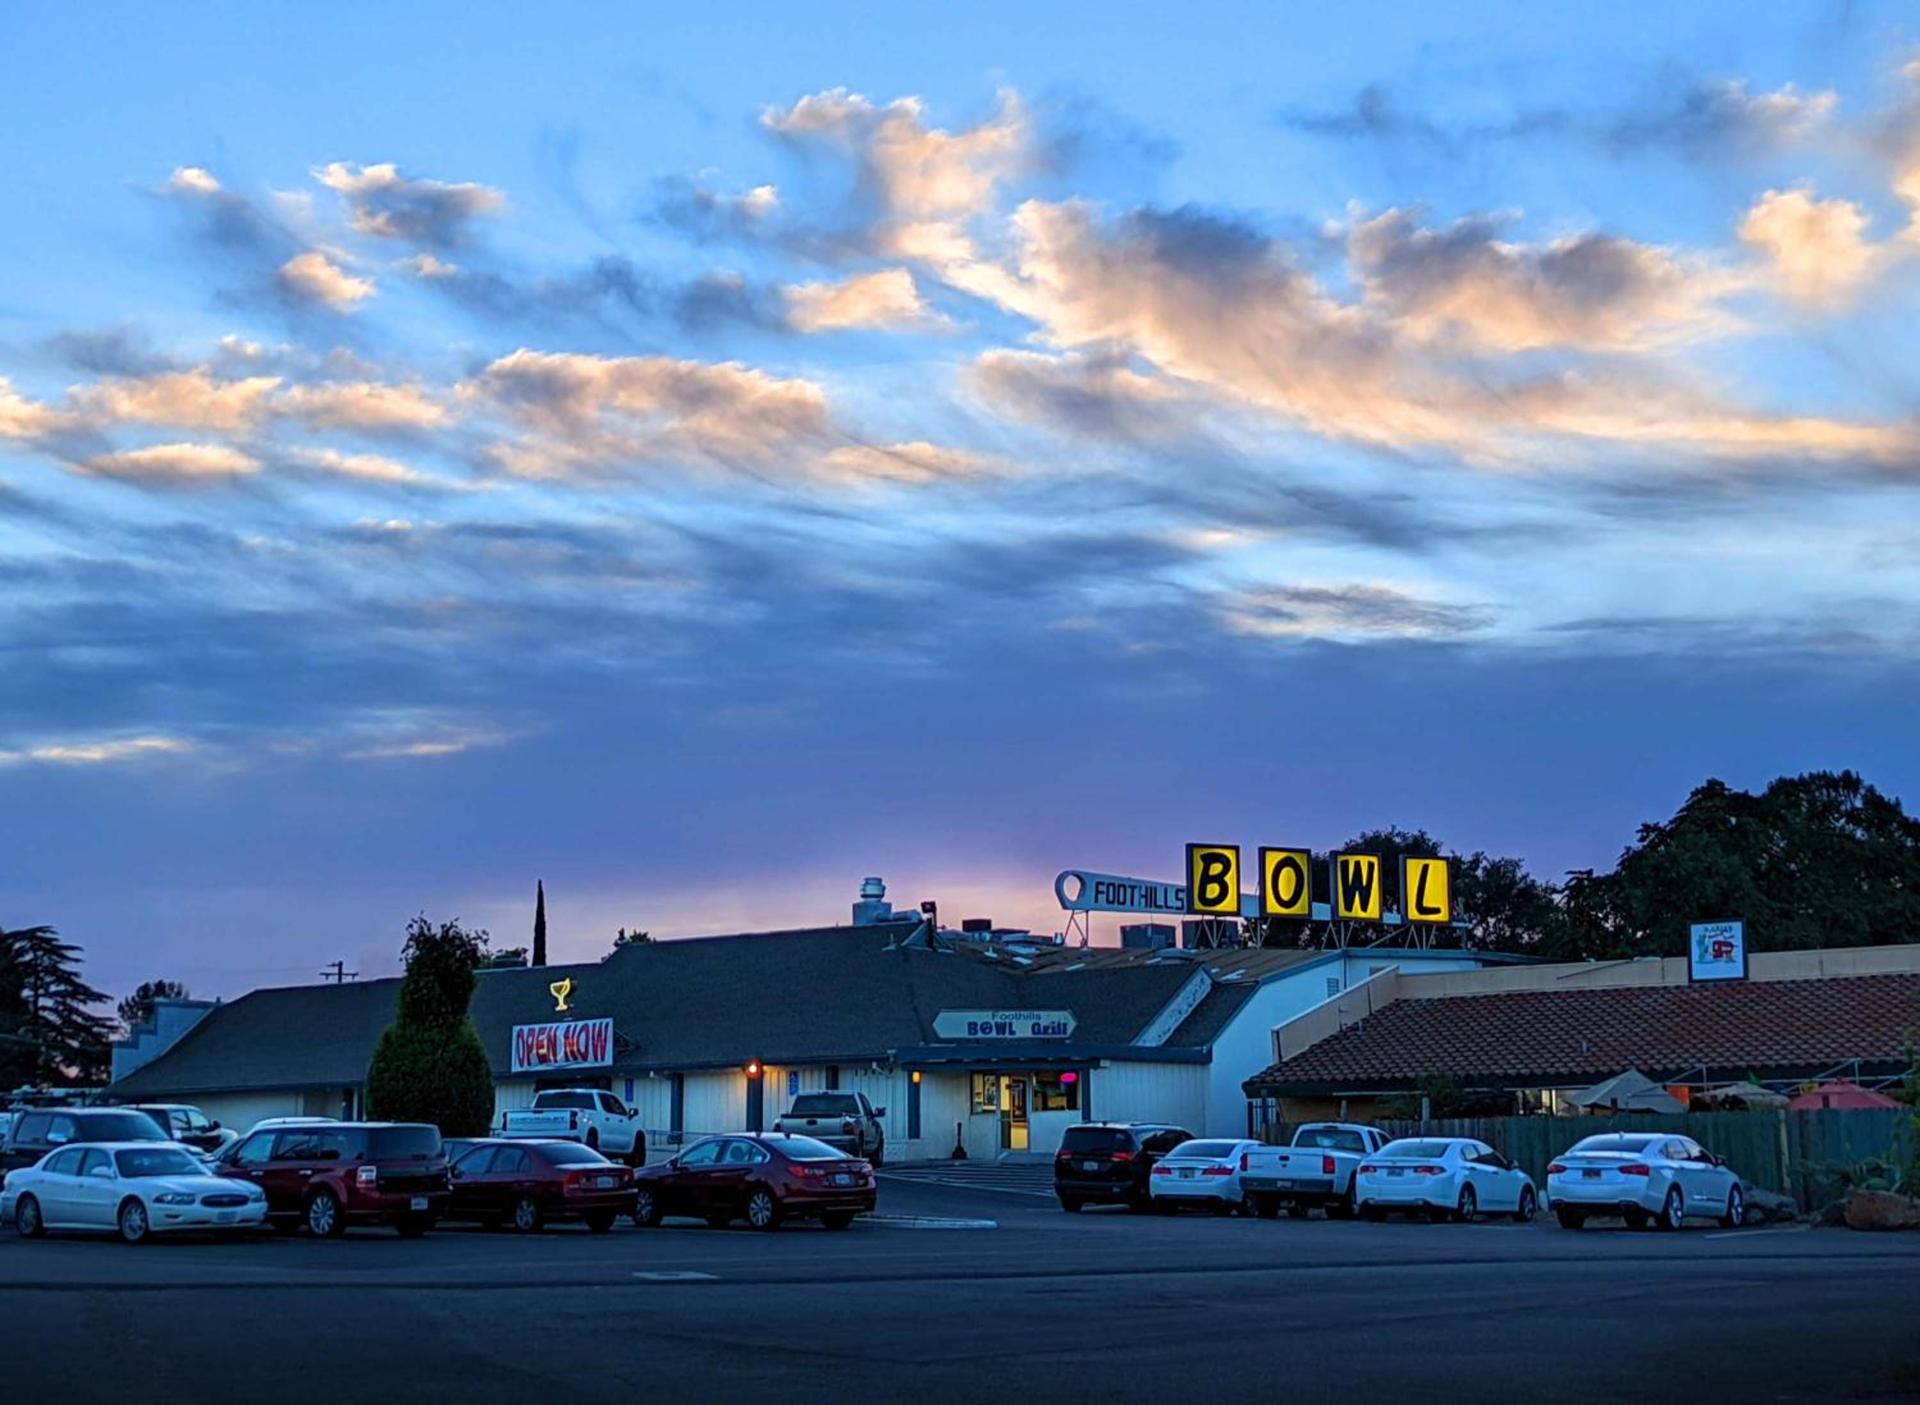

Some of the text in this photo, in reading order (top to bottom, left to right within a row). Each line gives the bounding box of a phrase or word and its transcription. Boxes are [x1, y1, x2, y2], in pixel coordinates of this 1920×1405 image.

[1094, 852, 1442, 916] FOOTHILLS BOWL
[967, 1021, 1068, 1036] BOWL Grill
[991, 1011, 1042, 1021] Foothills
[516, 1021, 609, 1069] OPEN NOW
